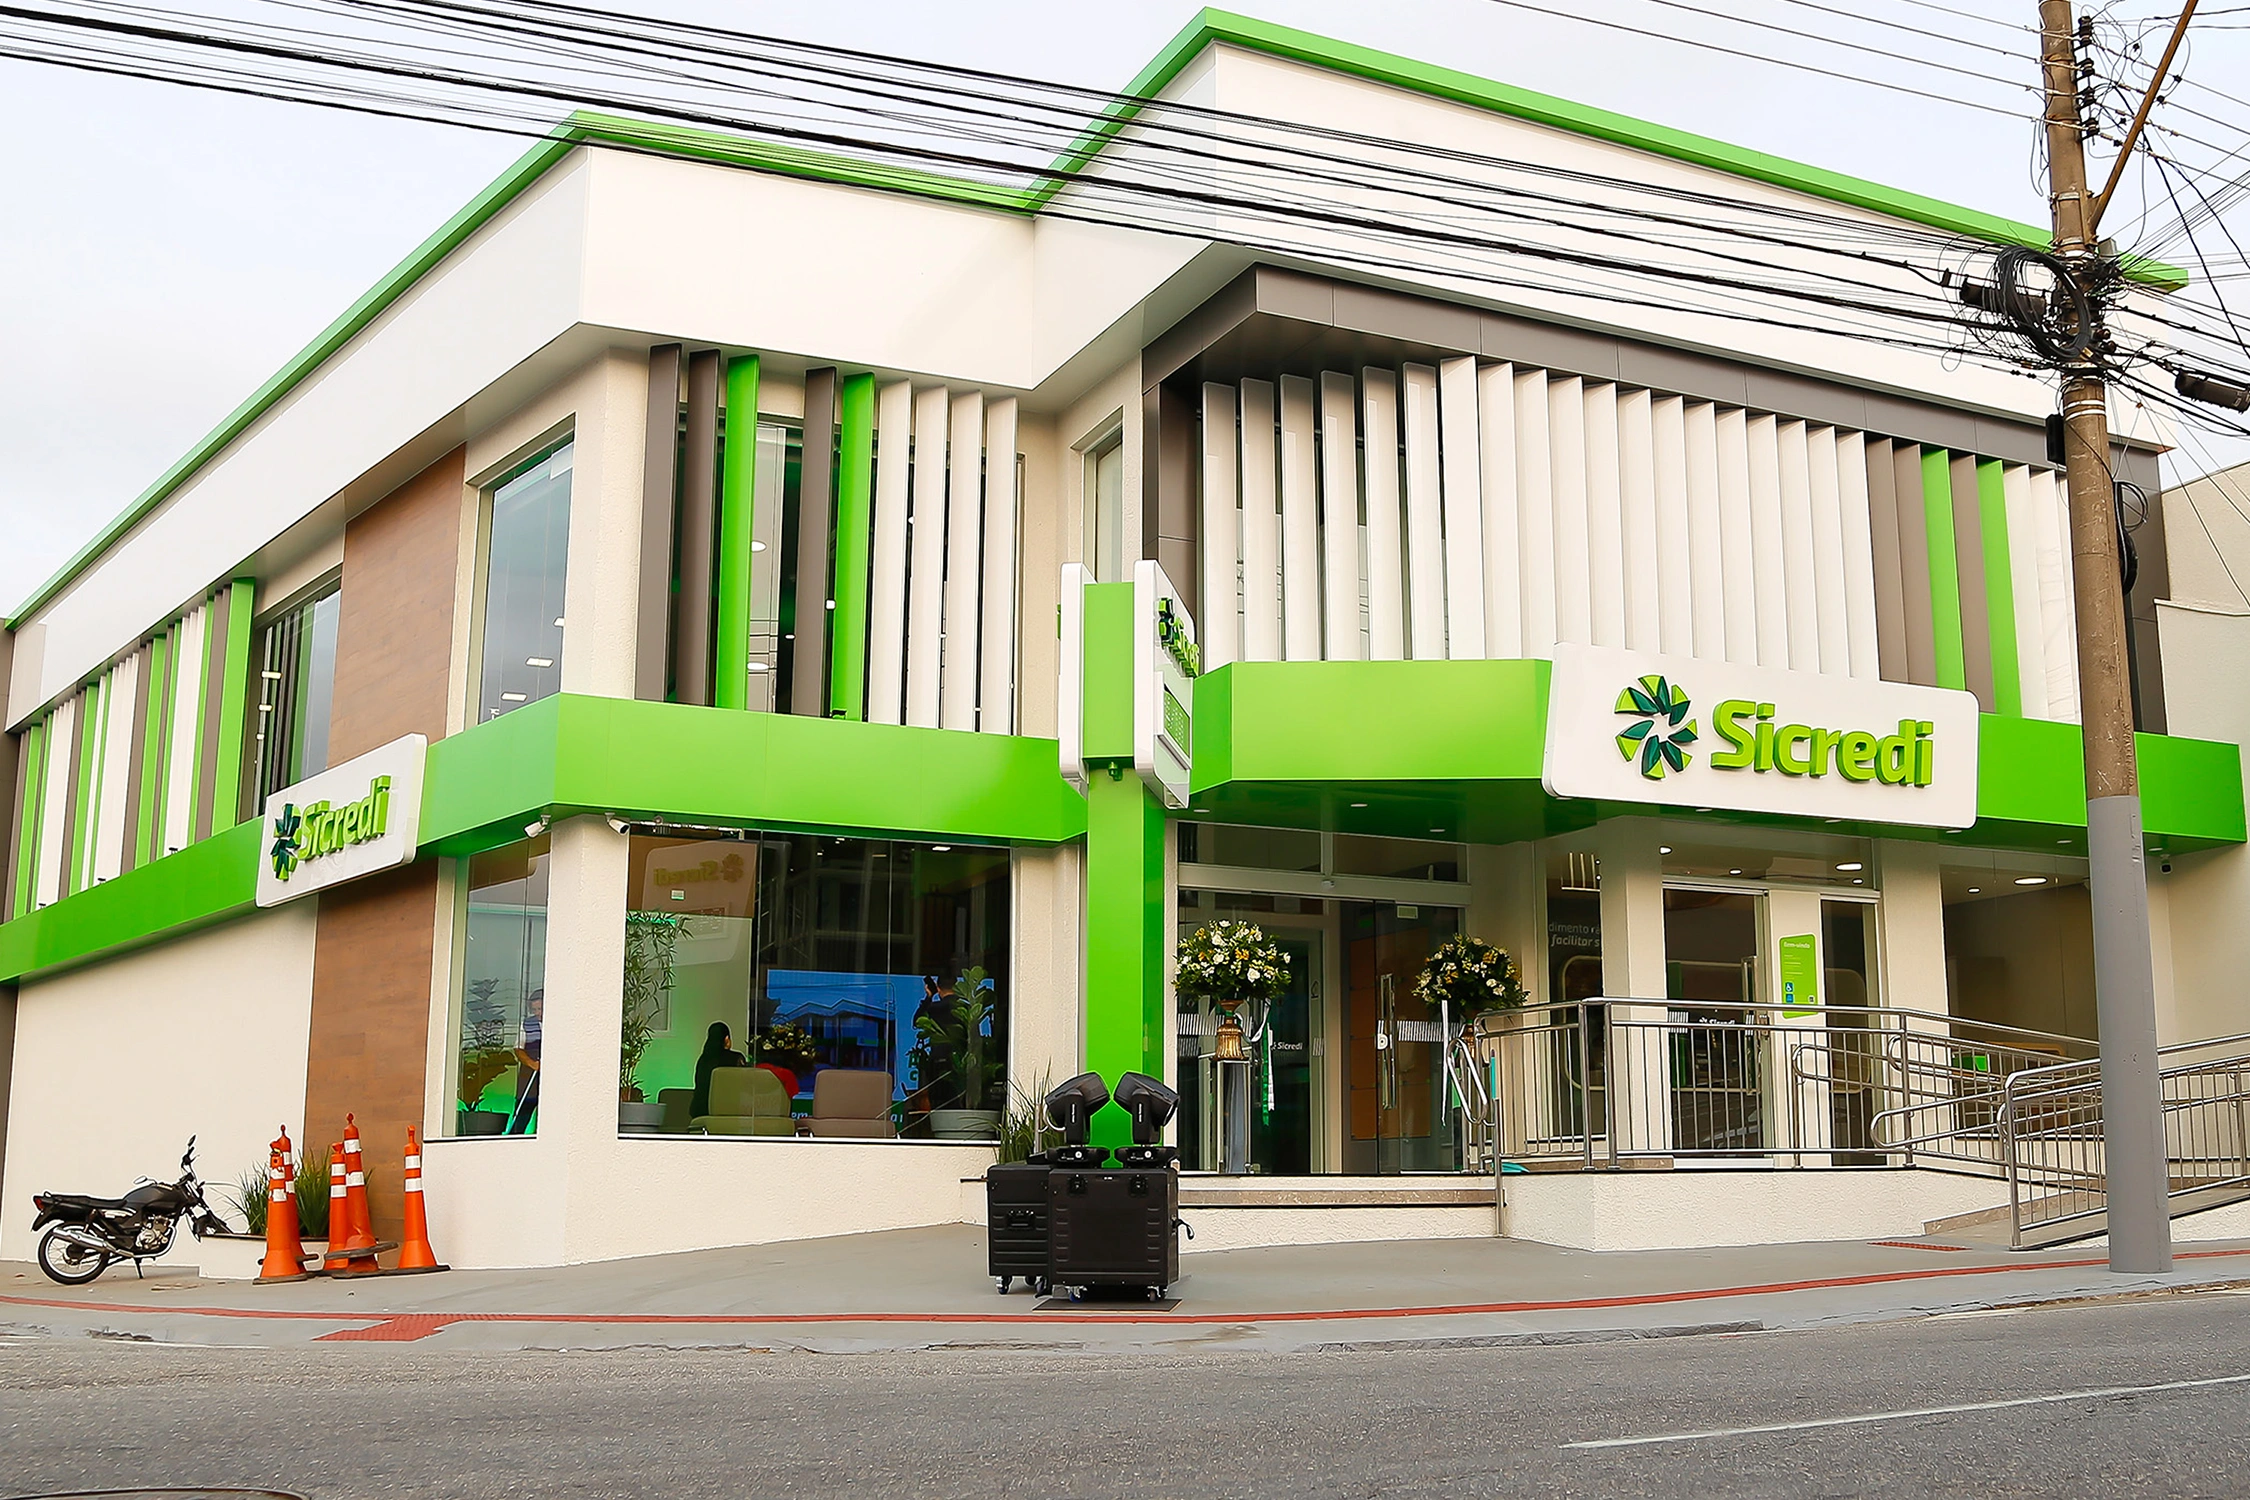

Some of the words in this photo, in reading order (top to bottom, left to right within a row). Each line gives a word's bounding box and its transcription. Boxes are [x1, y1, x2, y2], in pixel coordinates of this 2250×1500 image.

[1710, 699, 1934, 788] Sicredi
[297, 775, 392, 861] Sicredi
[1551, 933, 1593, 947] facilitar
[1277, 1041, 1303, 1050] Sicredi
